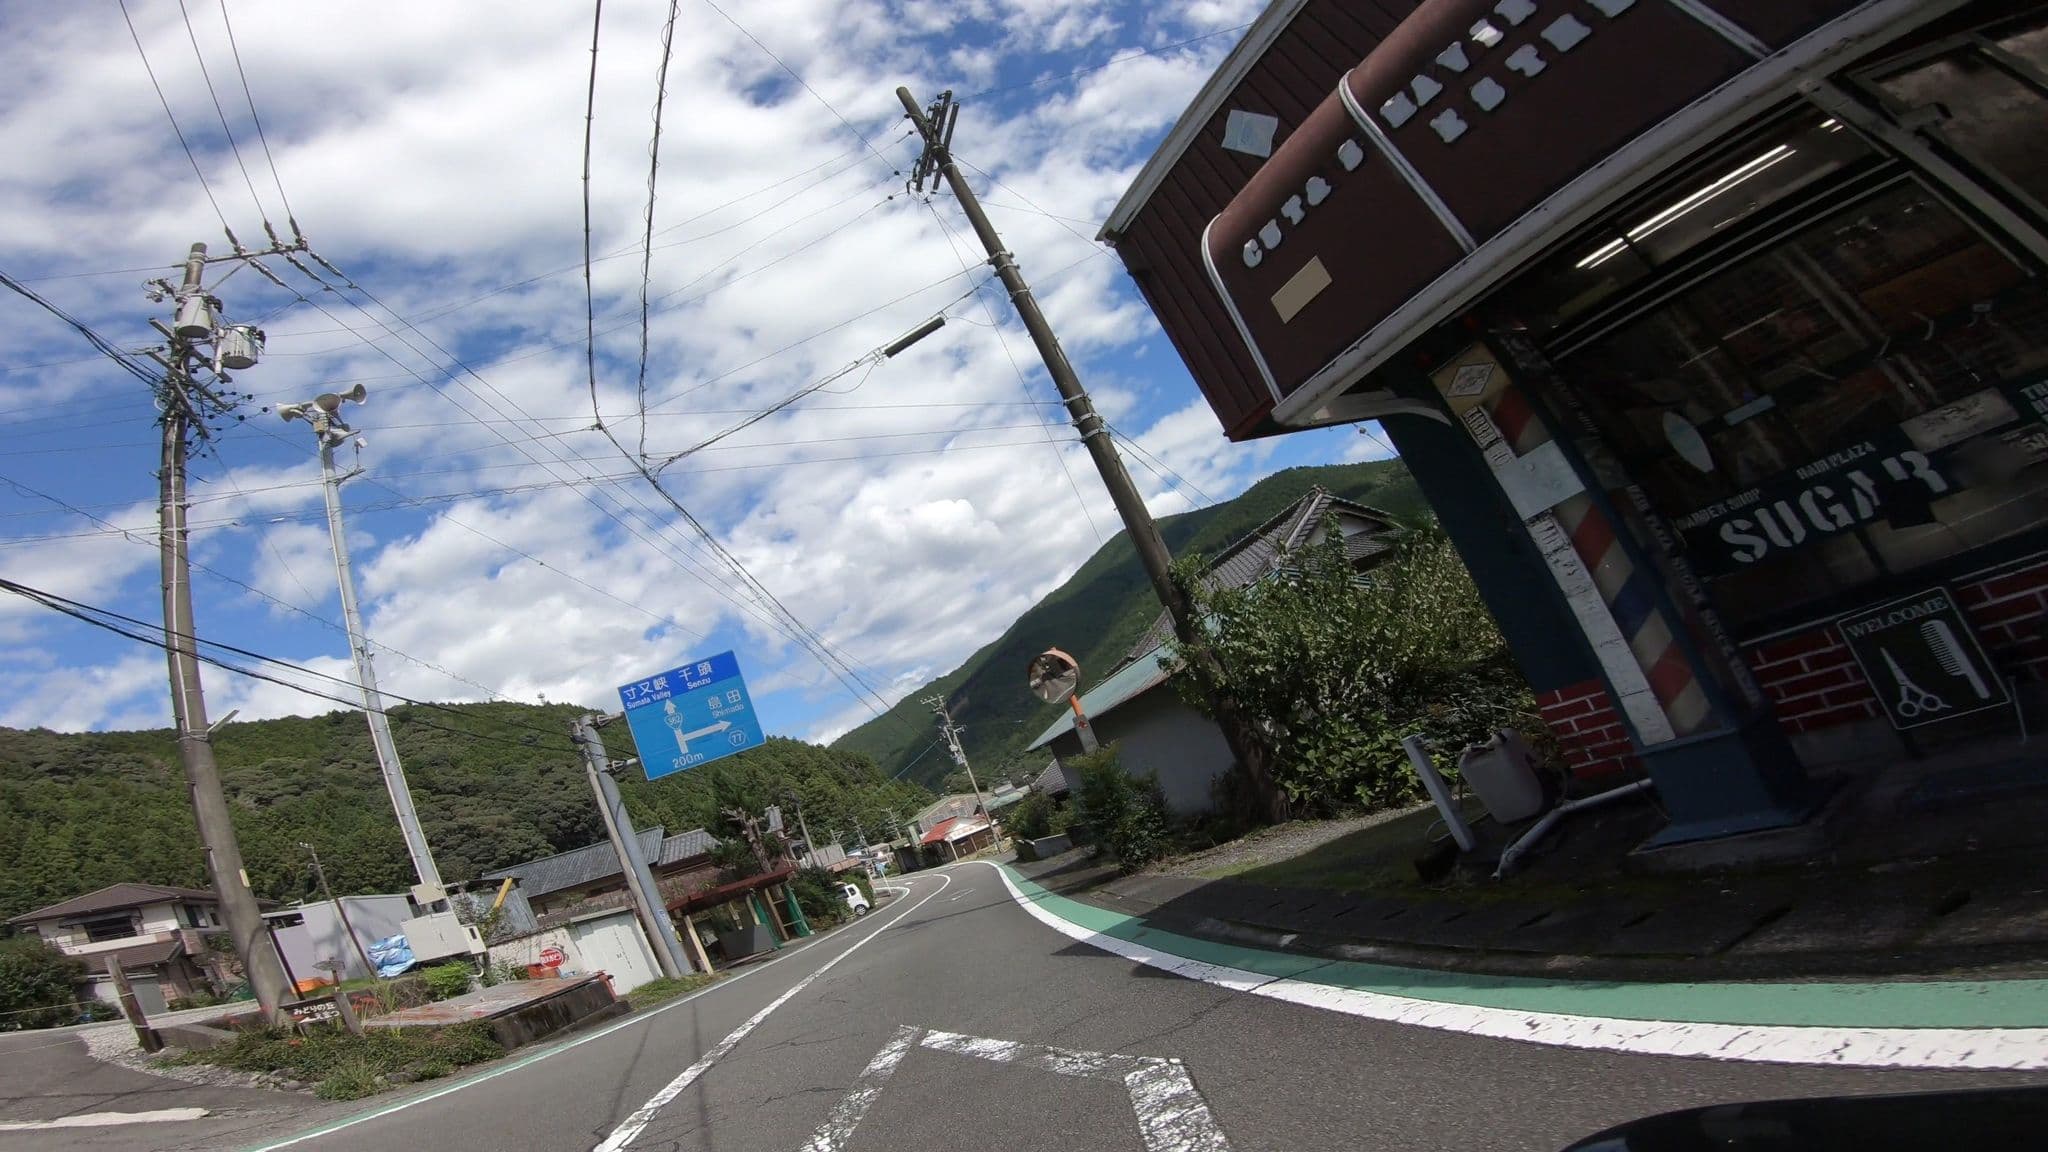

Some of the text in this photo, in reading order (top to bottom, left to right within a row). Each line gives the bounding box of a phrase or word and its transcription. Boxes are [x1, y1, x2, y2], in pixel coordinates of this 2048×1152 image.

[1795, 441, 1877, 480] HAIR PLAZA
[1719, 450, 1949, 563] SUGAR
[1847, 597, 1949, 638] WELCOME
[623, 661, 712, 700] 寸又峡 千頭
[651, 691, 671, 701] Valley
[687, 677, 711, 690] Senzu
[708, 688, 741, 710] 島田
[712, 703, 745, 718] Shimada
[732, 733, 742, 743] 77
[672, 752, 704, 768] 200m
[293, 1002, 337, 1016] みどりの丘
